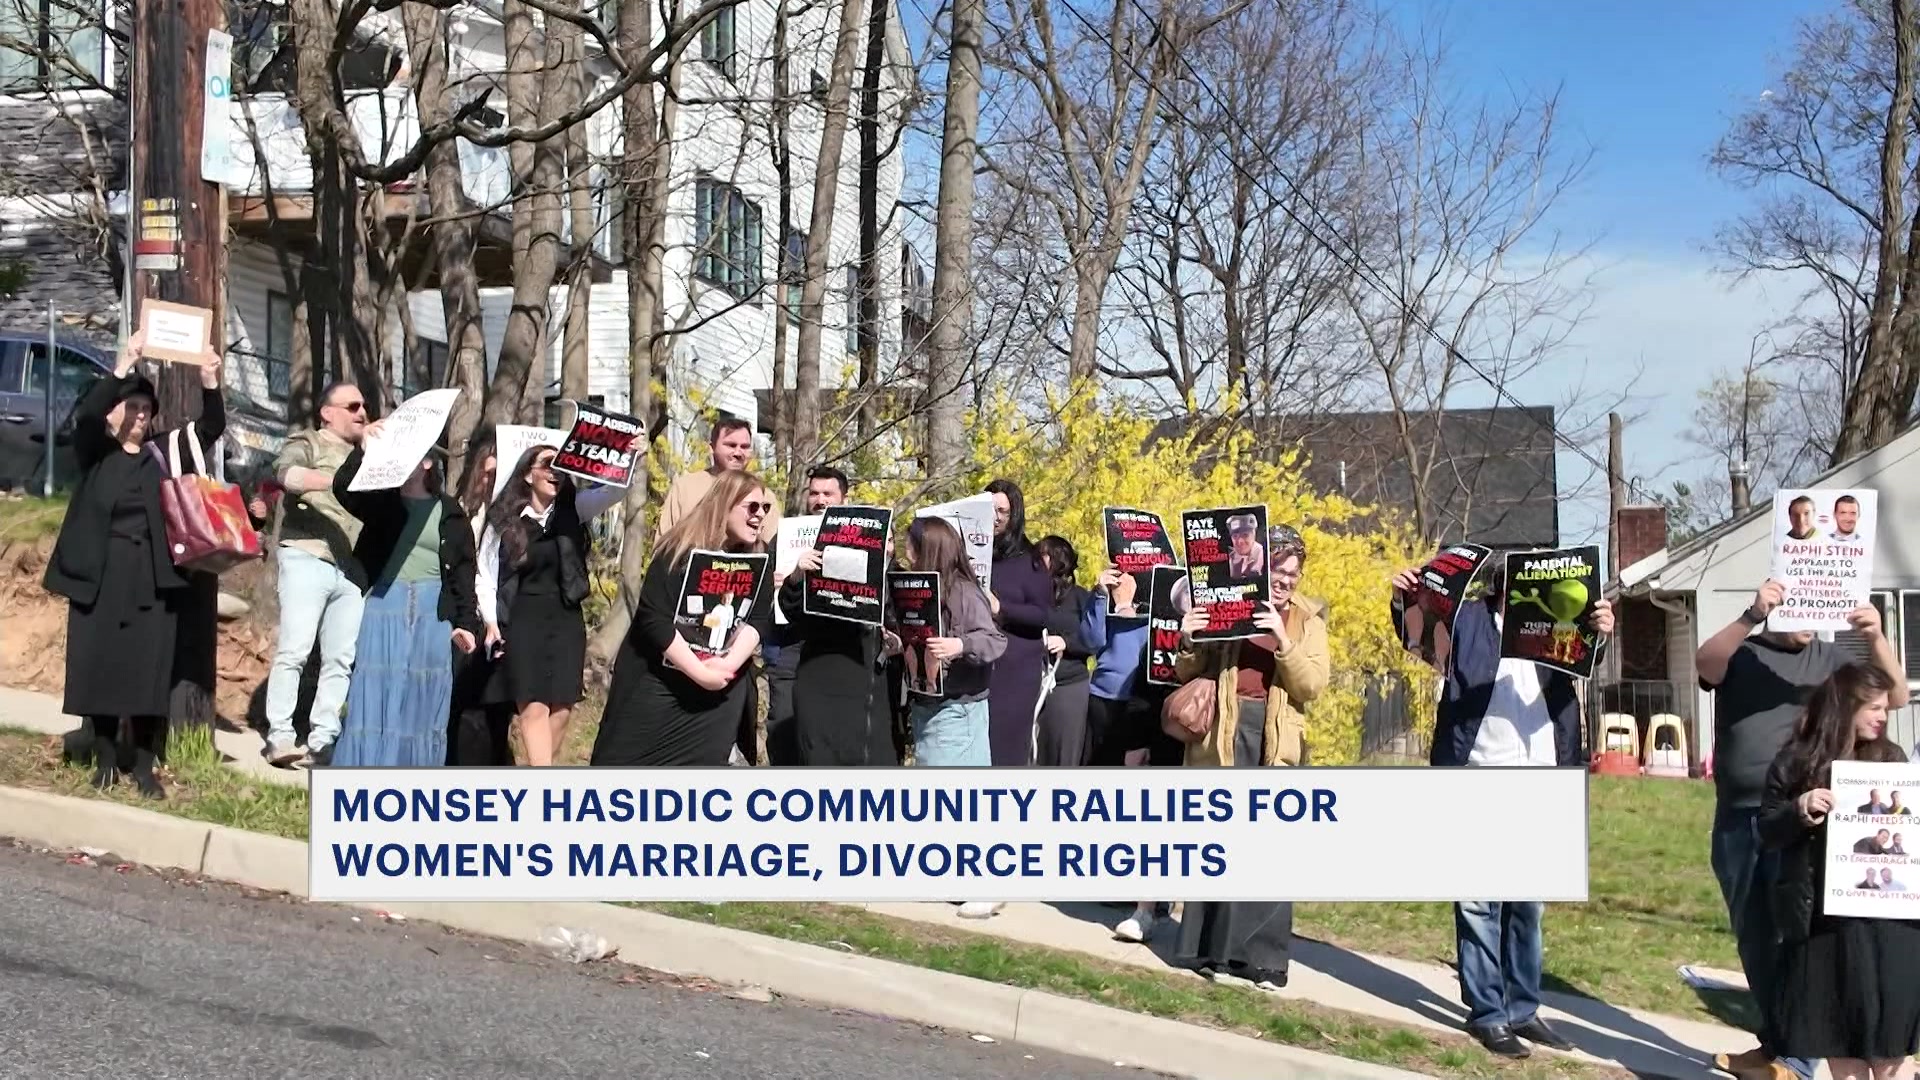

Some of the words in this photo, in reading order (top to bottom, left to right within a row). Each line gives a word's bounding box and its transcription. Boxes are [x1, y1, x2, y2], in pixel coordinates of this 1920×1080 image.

[565, 440, 578, 452] 5
[580, 443, 631, 468] YEARS
[1186, 518, 1214, 530] FAYE
[1187, 528, 1221, 540] STEIN,
[1783, 544, 1821, 556] RAPHI
[1826, 545, 1864, 557] STEIN
[1524, 556, 1584, 570] PARENTAL
[1791, 558, 1836, 567] APPEARS
[1840, 560, 1853, 568] TO
[701, 570, 731, 582] POST
[1515, 565, 1593, 580] ALIENATION?
[1786, 568, 1804, 576] USE
[1828, 570, 1857, 578] ALIAS
[923, 580, 930, 588] A
[1799, 579, 1842, 587] NATHAN
[1790, 588, 1850, 598] GETTISBERG
[1779, 610, 1825, 620] DELAYED
[1153, 650, 1164, 665] 5
[1835, 813, 1868, 824] RAPHI
[1871, 816, 1904, 825] NEEDS
[1835, 854, 1848, 863] TO
[1832, 889, 1844, 897] TO
[1846, 890, 1867, 898] GIVE
